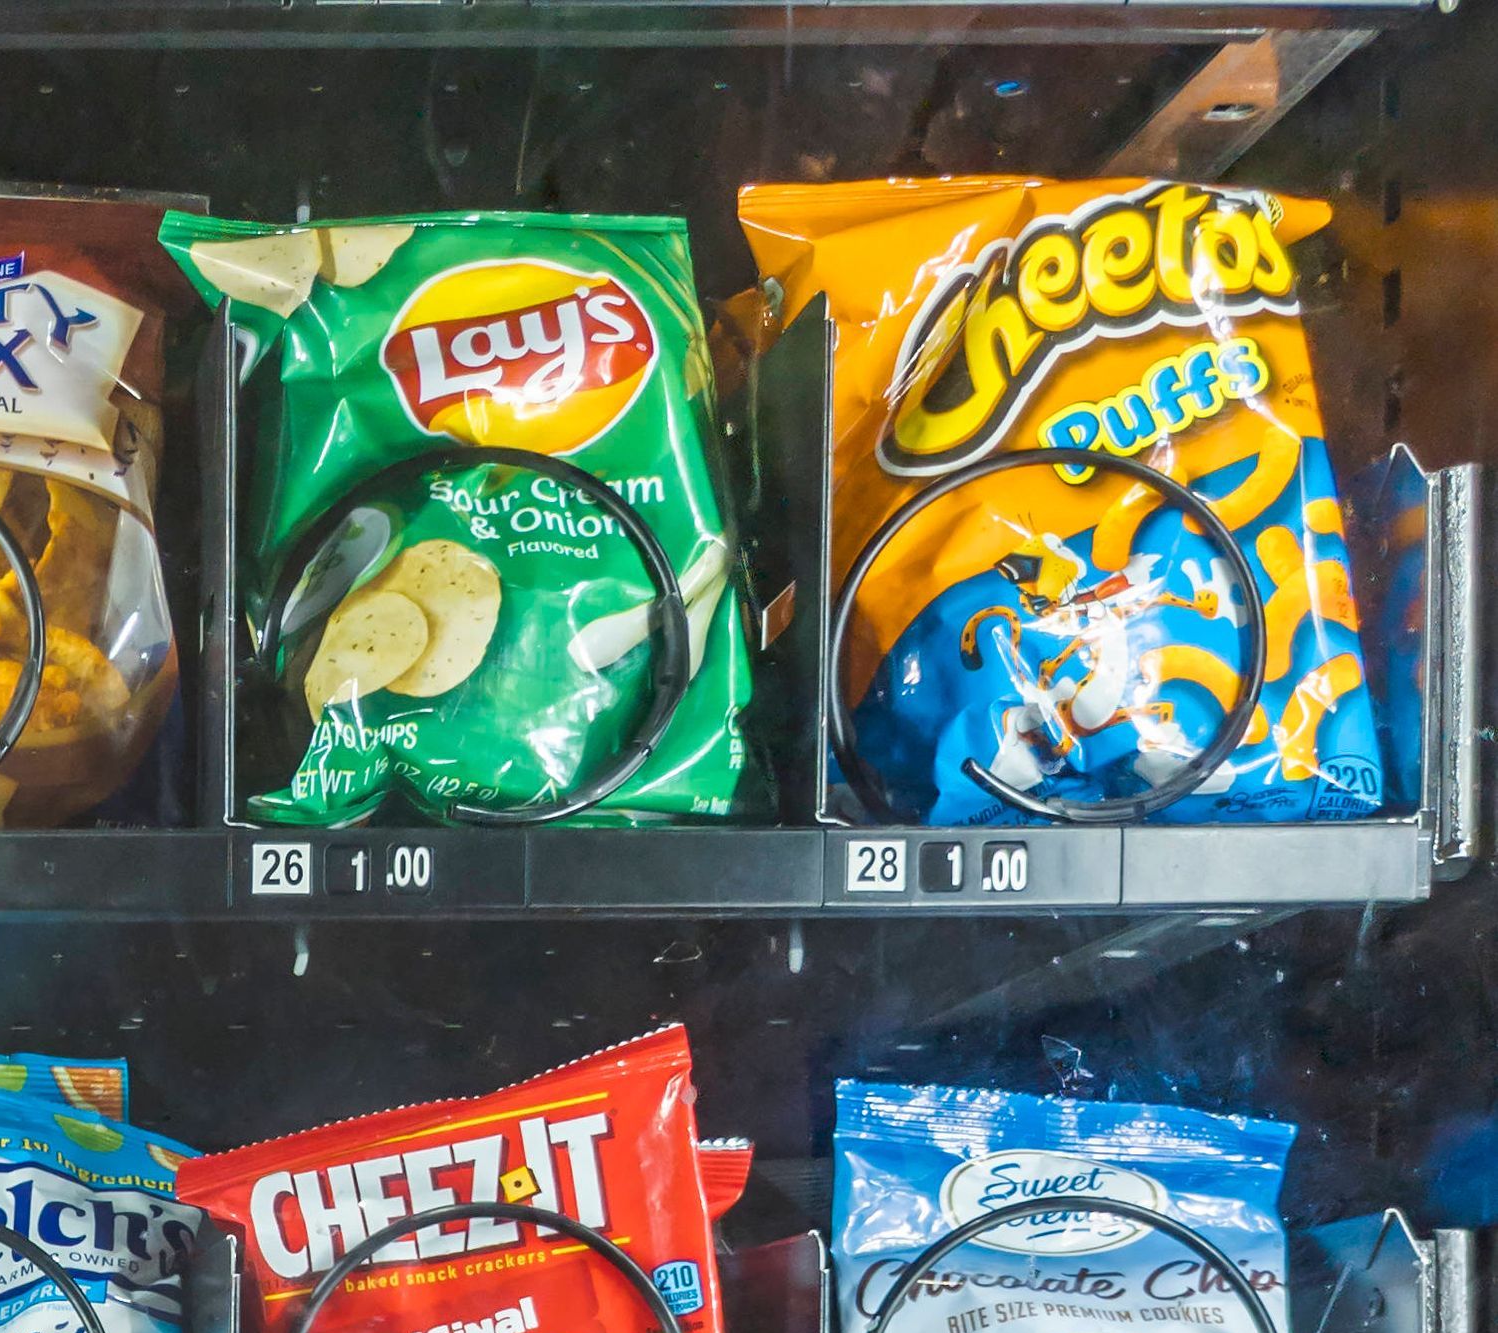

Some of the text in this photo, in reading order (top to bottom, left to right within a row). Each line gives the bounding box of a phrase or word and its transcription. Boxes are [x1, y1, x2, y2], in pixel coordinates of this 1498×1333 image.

[894, 186, 1295, 453] Cheetos
[411, 287, 633, 404] Lay's
[1046, 343, 1264, 473] Puffs
[429, 479, 519, 514] Sour
[507, 541, 599, 561] Flavored
[361, 722, 418, 751] CHIPS
[1322, 764, 1378, 798] 220
[260, 850, 303, 887] 26
[856, 847, 899, 884] 28
[984, 1164, 1119, 1200] Sweet
[69, 1250, 141, 1274] OWNED
[345, 1250, 547, 1294] baked snack crackers
[656, 1265, 694, 1291] 210
[997, 1301, 1039, 1324] SIZE
[1045, 1303, 1133, 1324] PREMIUM
[1140, 1306, 1225, 1326] COOKIES
